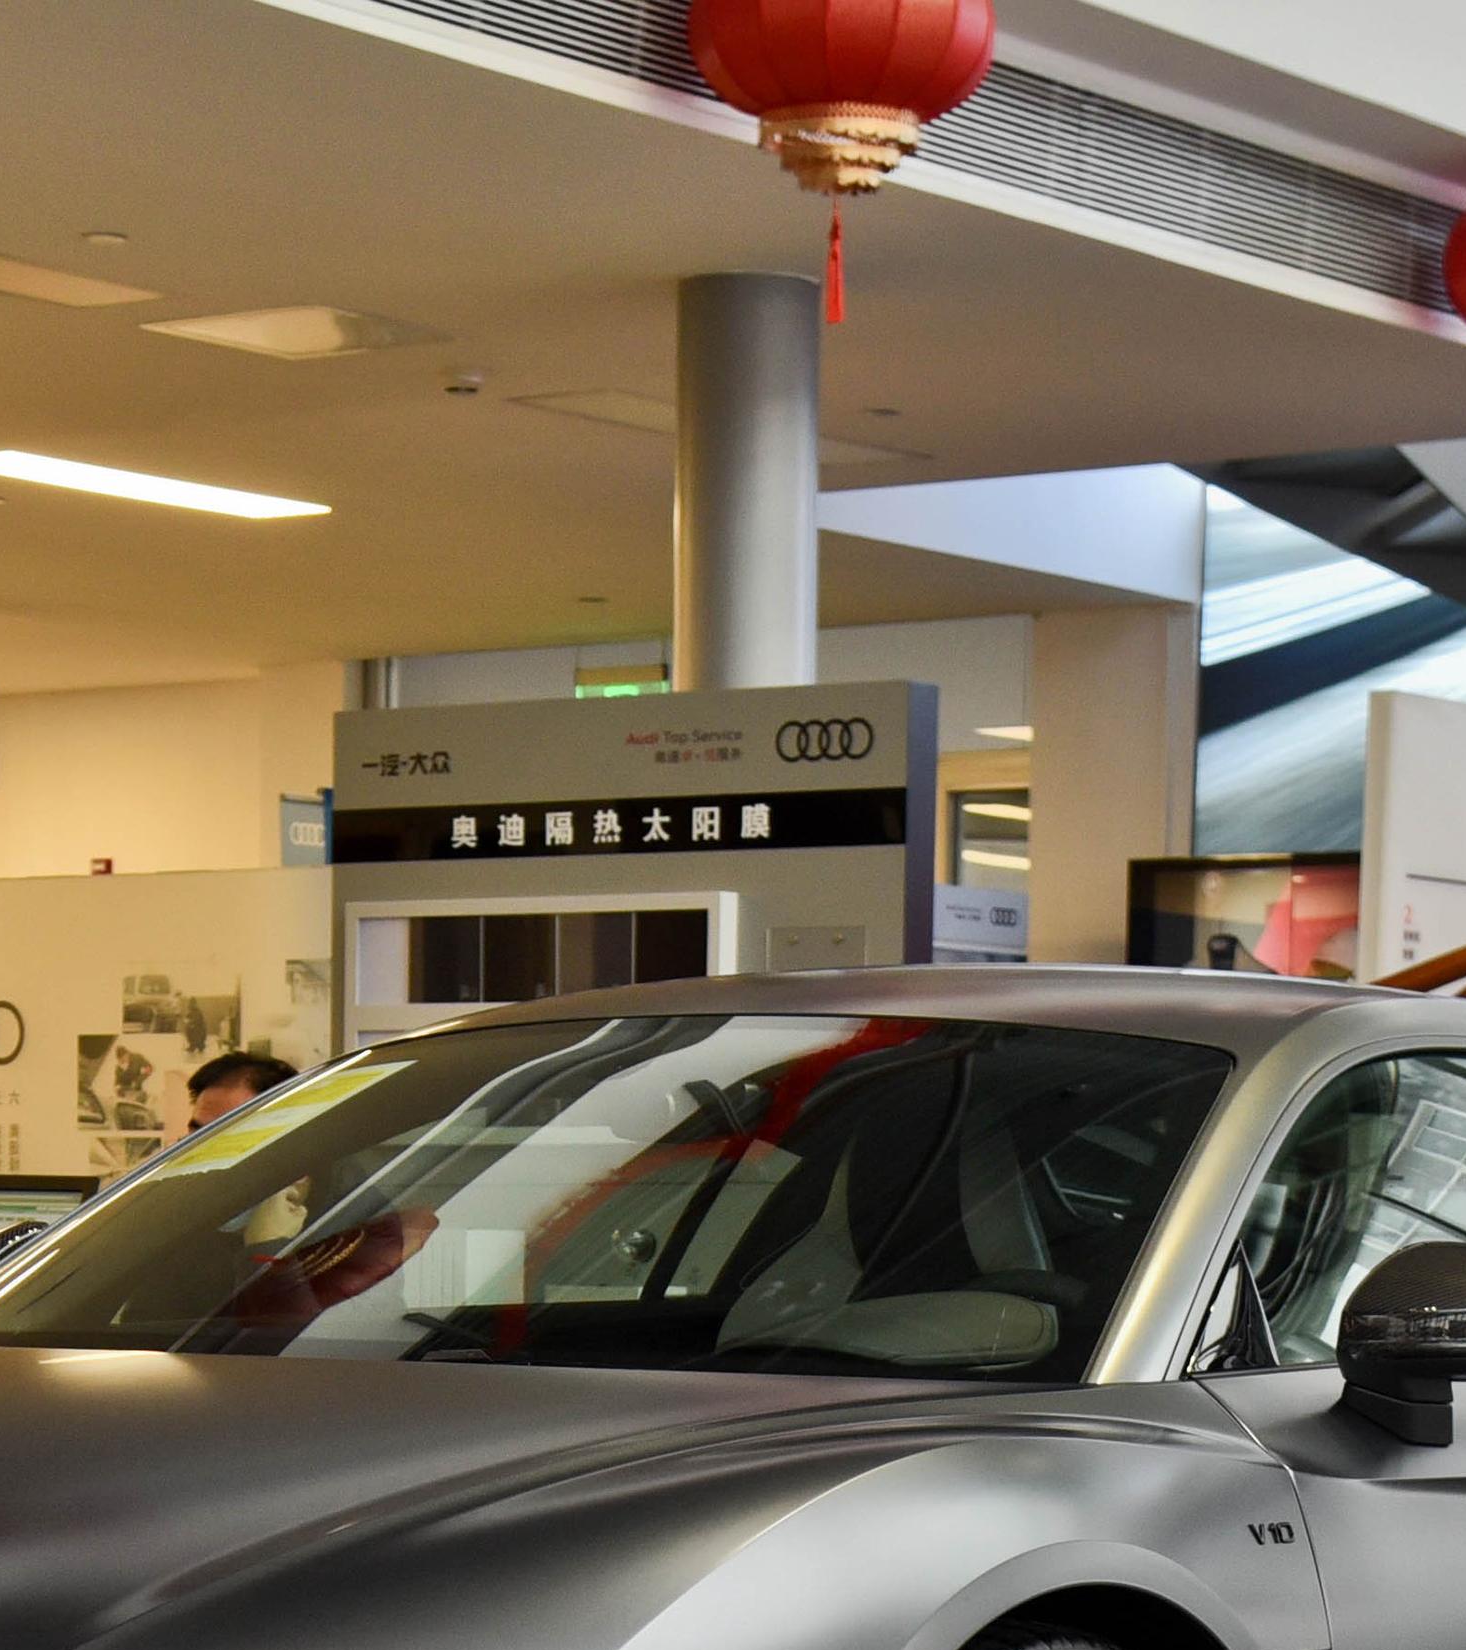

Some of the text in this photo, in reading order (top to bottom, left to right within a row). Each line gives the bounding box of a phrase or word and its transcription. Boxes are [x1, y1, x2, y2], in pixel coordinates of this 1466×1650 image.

[625, 729, 742, 745] Audi Top Service
[450, 803, 772, 848] 奥迪隔热太阳膜
[1247, 1521, 1295, 1546] V10
